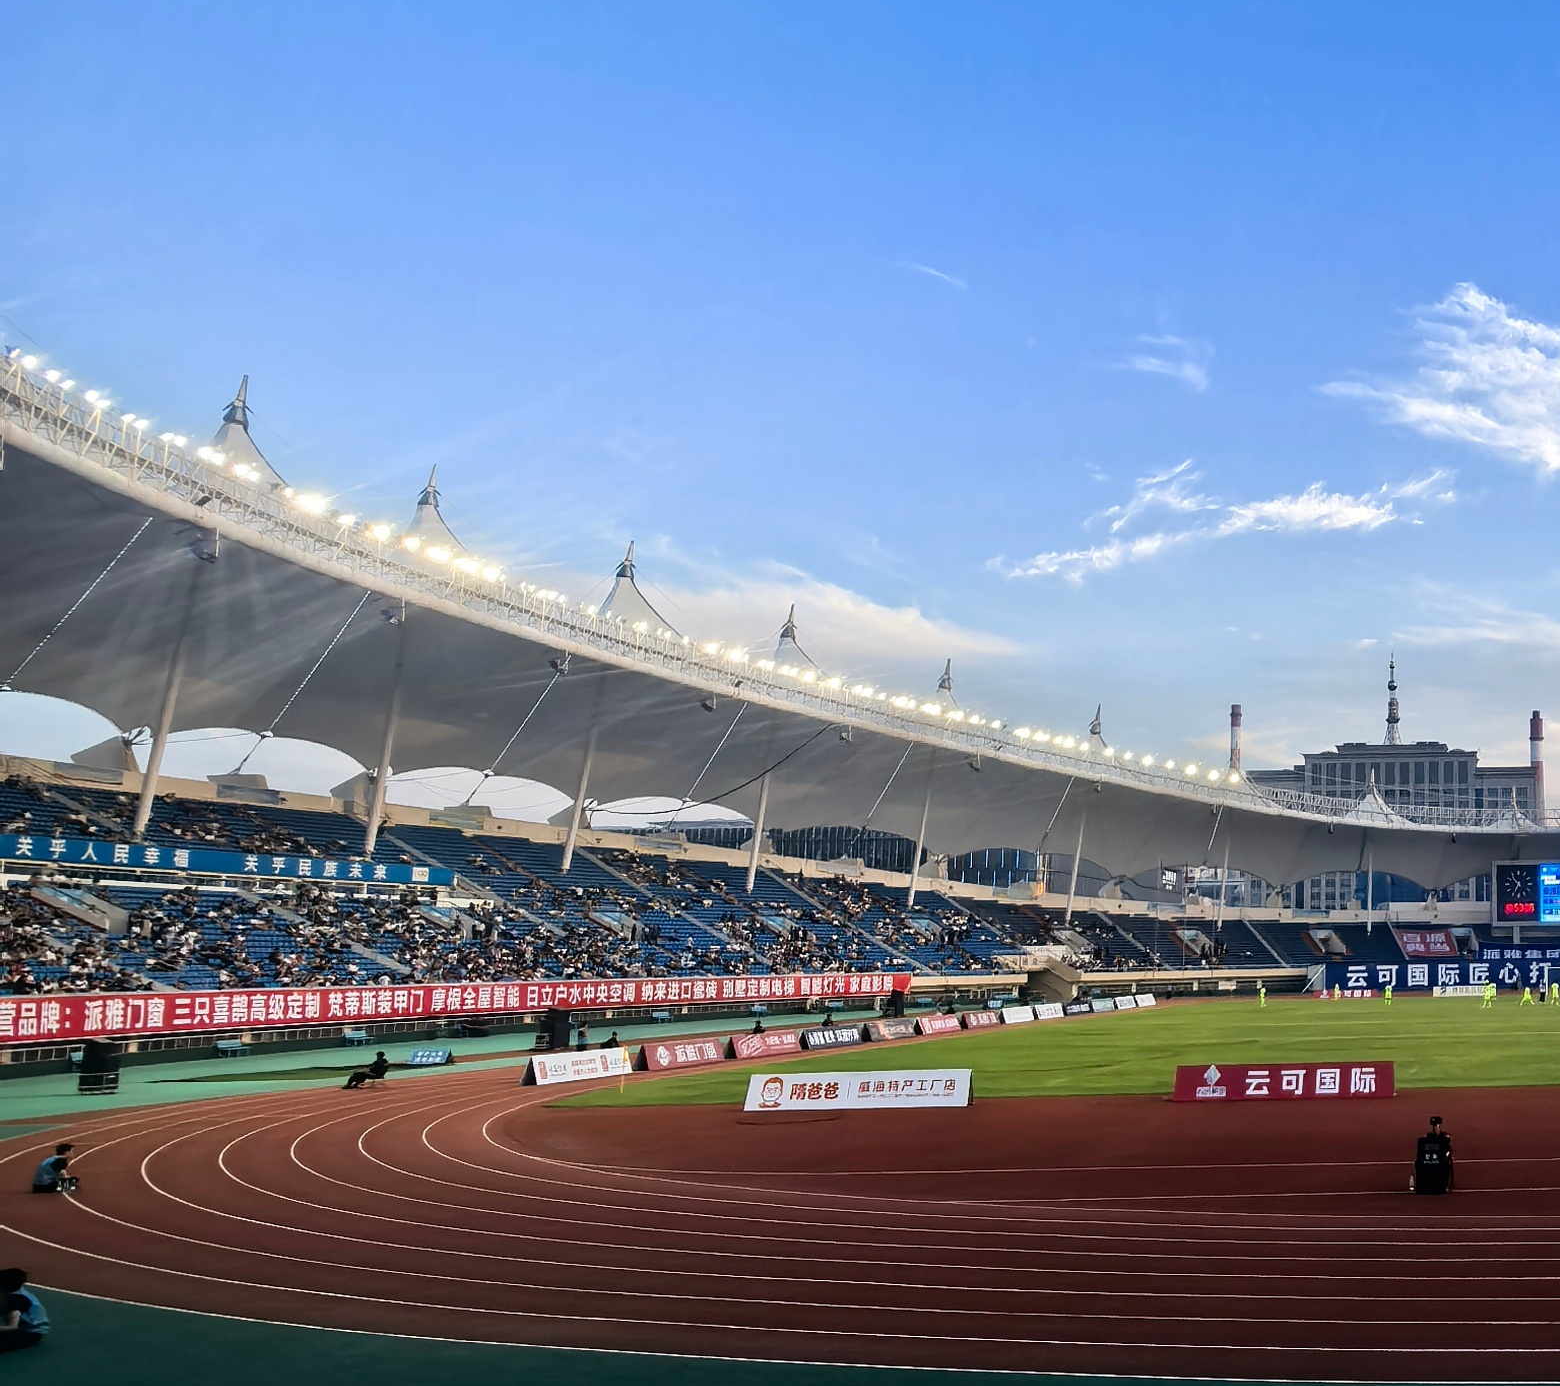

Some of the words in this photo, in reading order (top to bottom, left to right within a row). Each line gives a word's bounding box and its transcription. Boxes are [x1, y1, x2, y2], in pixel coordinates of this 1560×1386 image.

[15, 836, 191, 868] 关乎人民幸福
[244, 854, 388, 880] 关乎民族未来
[84, 998, 165, 1031] 派雅门窗
[328, 989, 424, 1017] 梵蒂斯装甲门
[430, 985, 520, 1011] 摩根全屋智能
[800, 974, 845, 995] 智能灯光
[849, 974, 894, 994] 家庭影院
[1245, 1067, 1376, 1095] 云可国际
